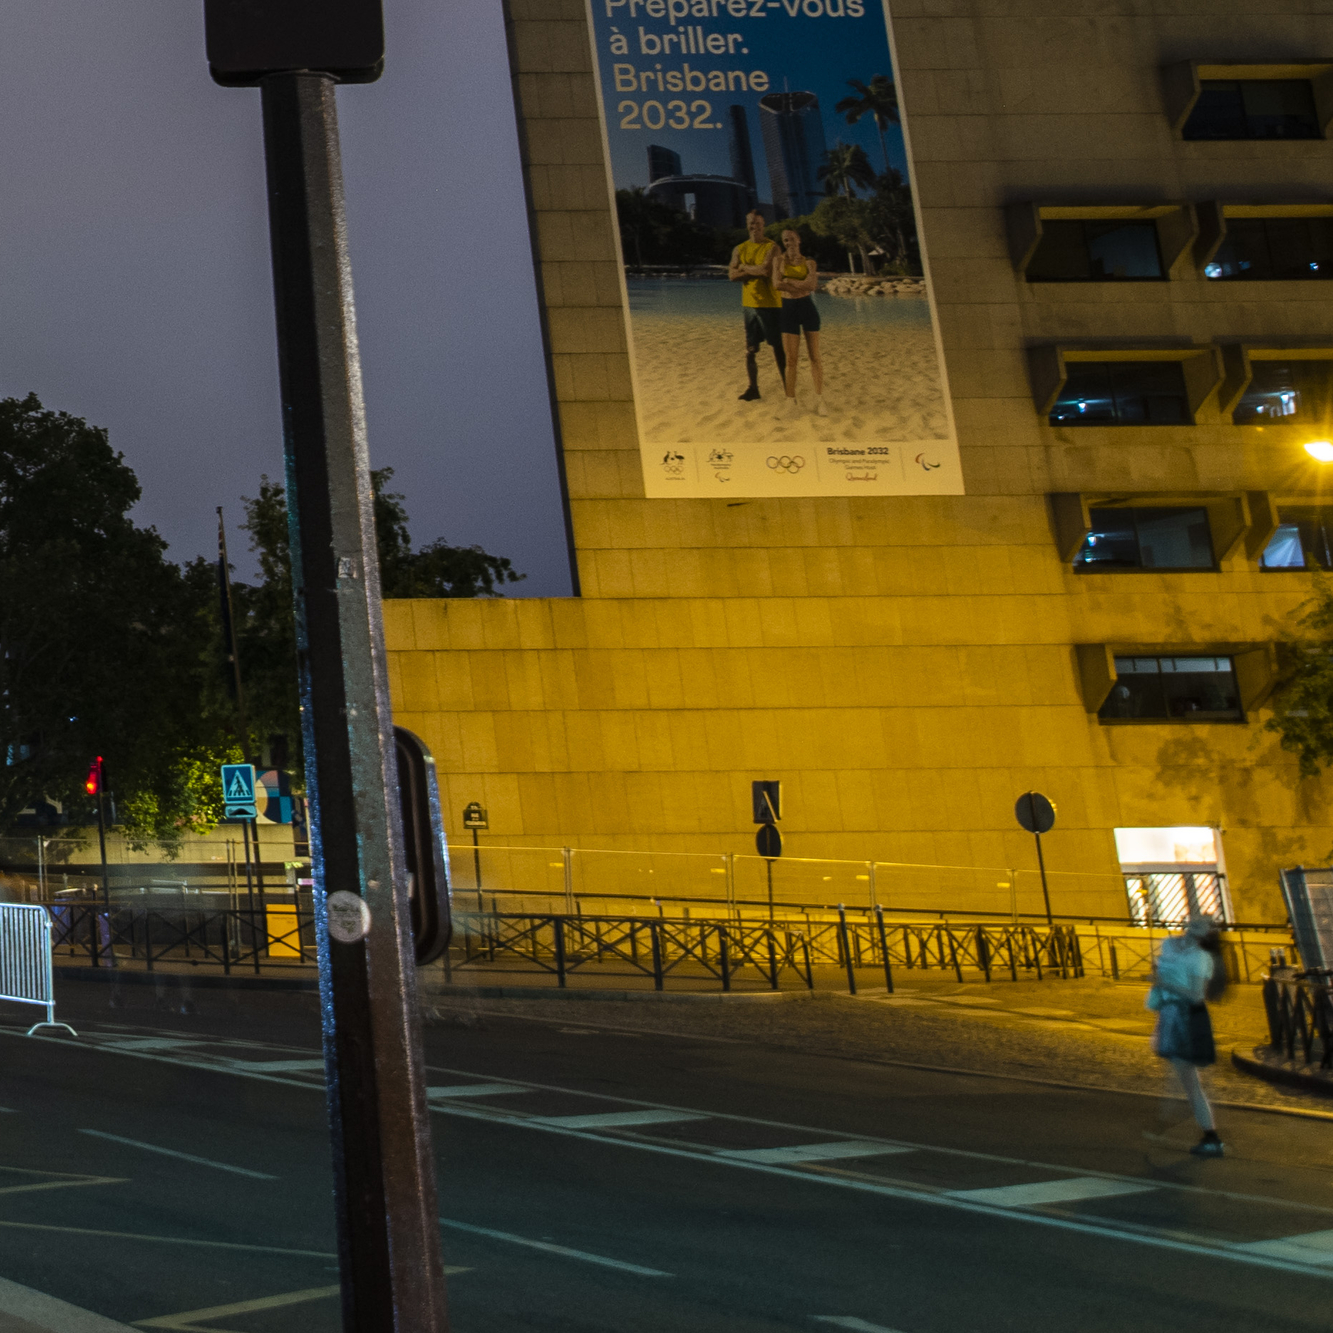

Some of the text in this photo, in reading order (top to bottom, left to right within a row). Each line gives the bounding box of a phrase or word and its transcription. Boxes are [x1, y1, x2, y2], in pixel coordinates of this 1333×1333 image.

[609, 26, 749, 54] à briller.
[613, 63, 769, 92] Brisbane
[617, 99, 723, 130] 2032.
[827, 447, 889, 455] Brisbane 2032
